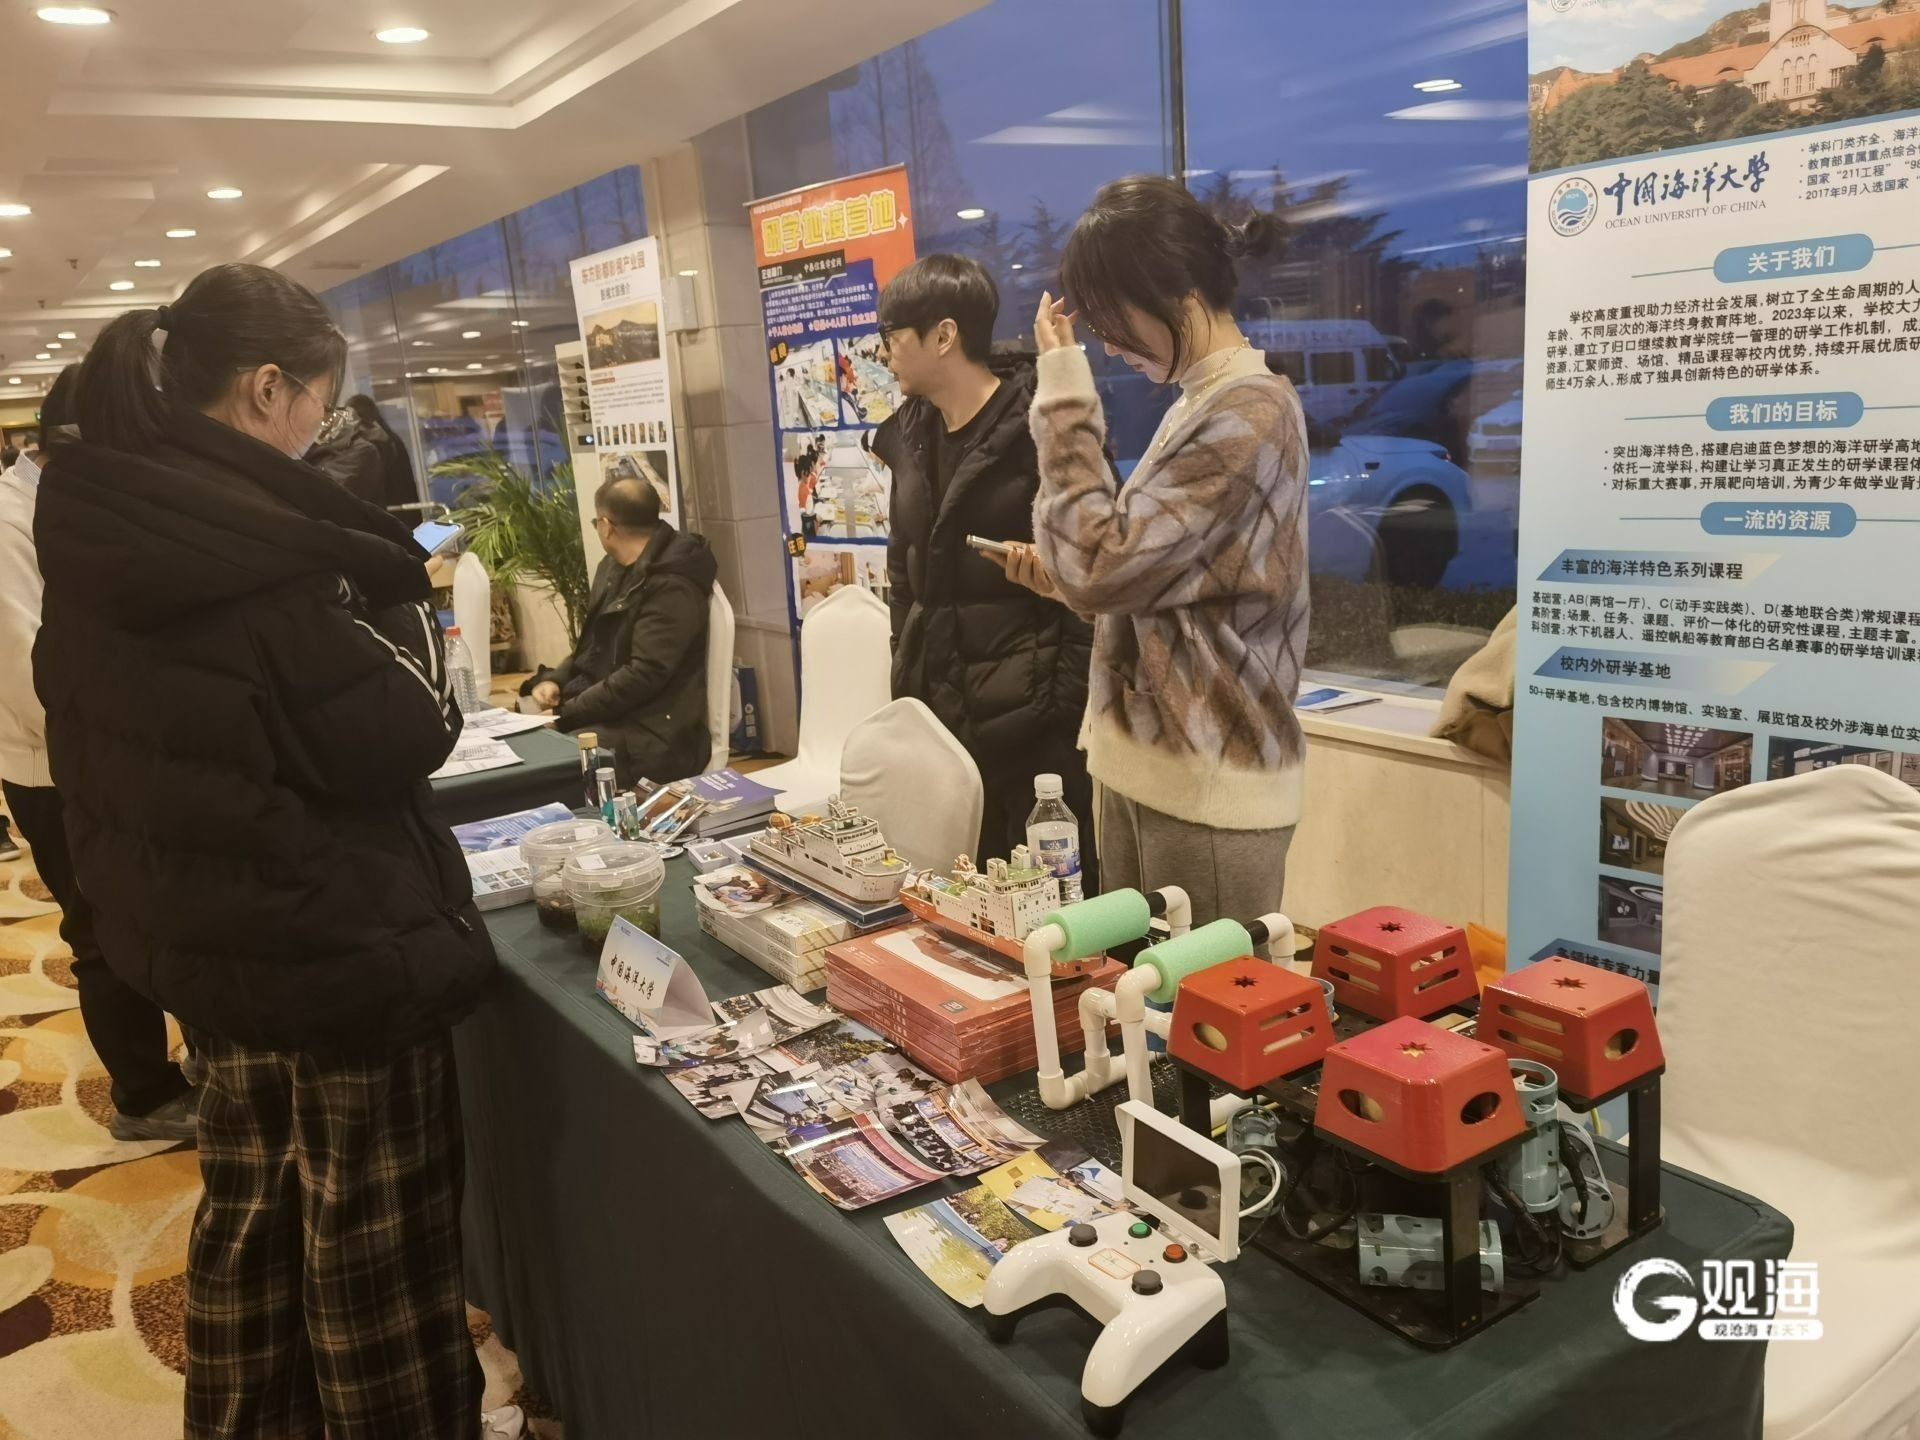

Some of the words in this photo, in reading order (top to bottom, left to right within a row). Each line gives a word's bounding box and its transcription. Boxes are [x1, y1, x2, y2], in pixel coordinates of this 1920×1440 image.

[1808, 126, 1920, 155] 学科门类齐全、海洋
[1808, 144, 1920, 171] 教育部直属重点综合
[1605, 216, 1641, 230] OCEAN
[1645, 207, 1710, 224] UNIVERSITY
[1712, 204, 1728, 215] OF
[1730, 200, 1766, 214] CHINA
[1748, 245, 1836, 274] 关于我们
[1546, 318, 1920, 359] 研学，建立了归口继续教育学院统一管理的研学工作机制，成
[1546, 360, 1820, 391] 师生4万余人，形成了独具创新特色的研学体系。
[1730, 400, 1838, 424] 我们的目标
[1612, 475, 1920, 491] 对标重大赛事，开展靶向培训，为青少年做学业背
[1724, 510, 1832, 532] 一流的资源
[1561, 558, 1744, 580] 丰富的海洋特色系列课程
[1531, 621, 1920, 664] 科创营：水下机器人、遥控帆船等教育部白名单赛事的研学培训课
[1560, 656, 1672, 680] 校内外研学基地
